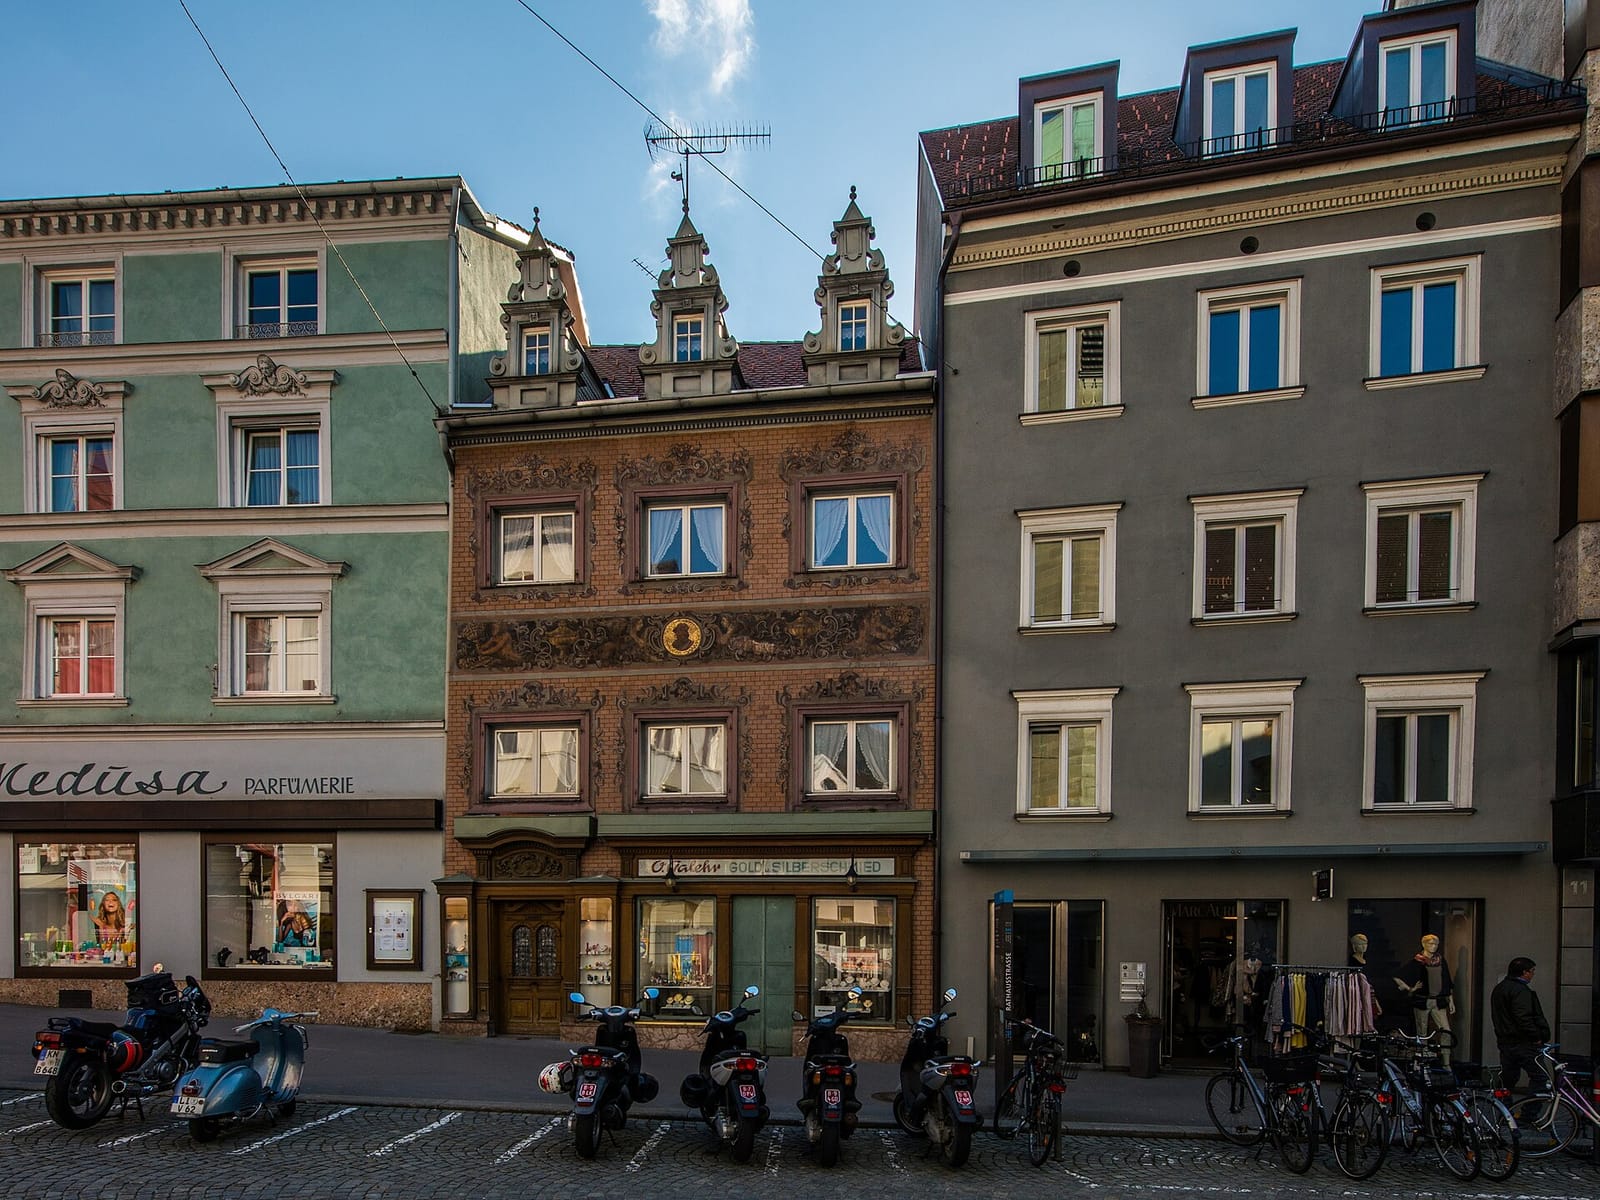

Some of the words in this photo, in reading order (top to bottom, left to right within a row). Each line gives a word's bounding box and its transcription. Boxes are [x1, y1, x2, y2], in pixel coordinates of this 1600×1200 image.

[244, 776, 356, 795] PARFÜMERIE
[1570, 880, 1588, 896] 11
[185, 1105, 196, 1113] 62
